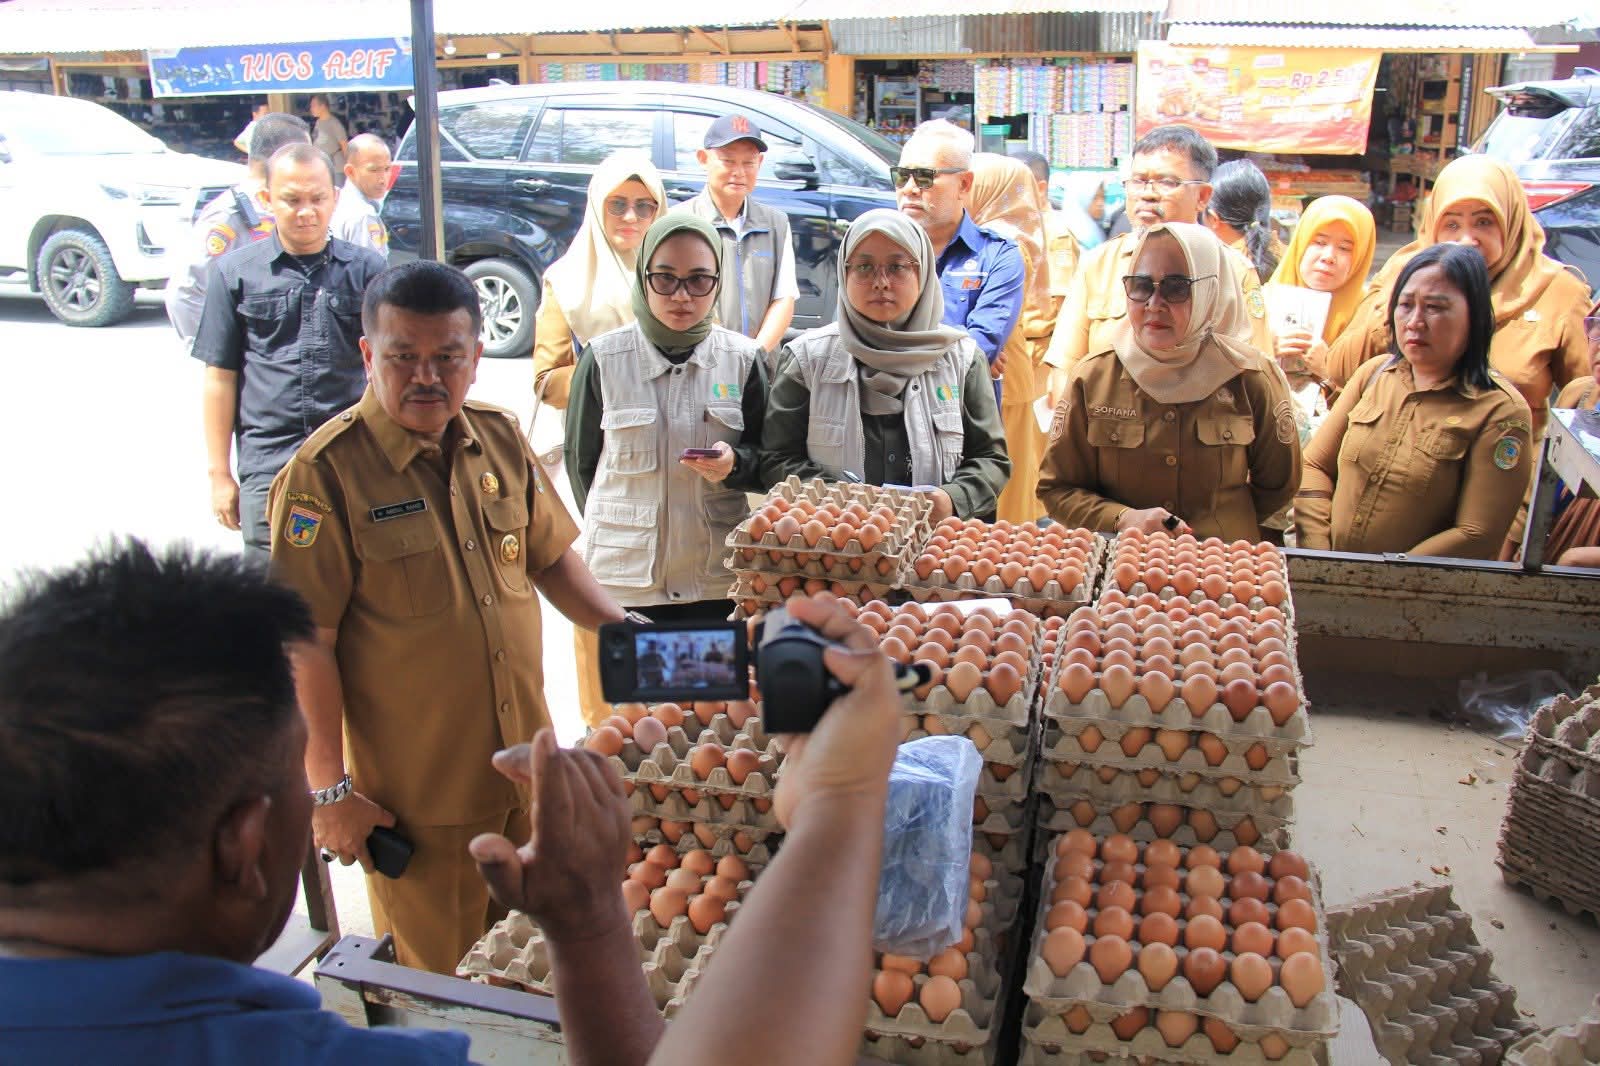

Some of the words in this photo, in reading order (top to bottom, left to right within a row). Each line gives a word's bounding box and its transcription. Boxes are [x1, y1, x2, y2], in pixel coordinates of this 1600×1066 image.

[240, 52, 314, 82] KIOS
[322, 49, 396, 79] ALIF
[1291, 73, 1313, 87] Rp
[1094, 405, 1137, 417] SOFIANA
